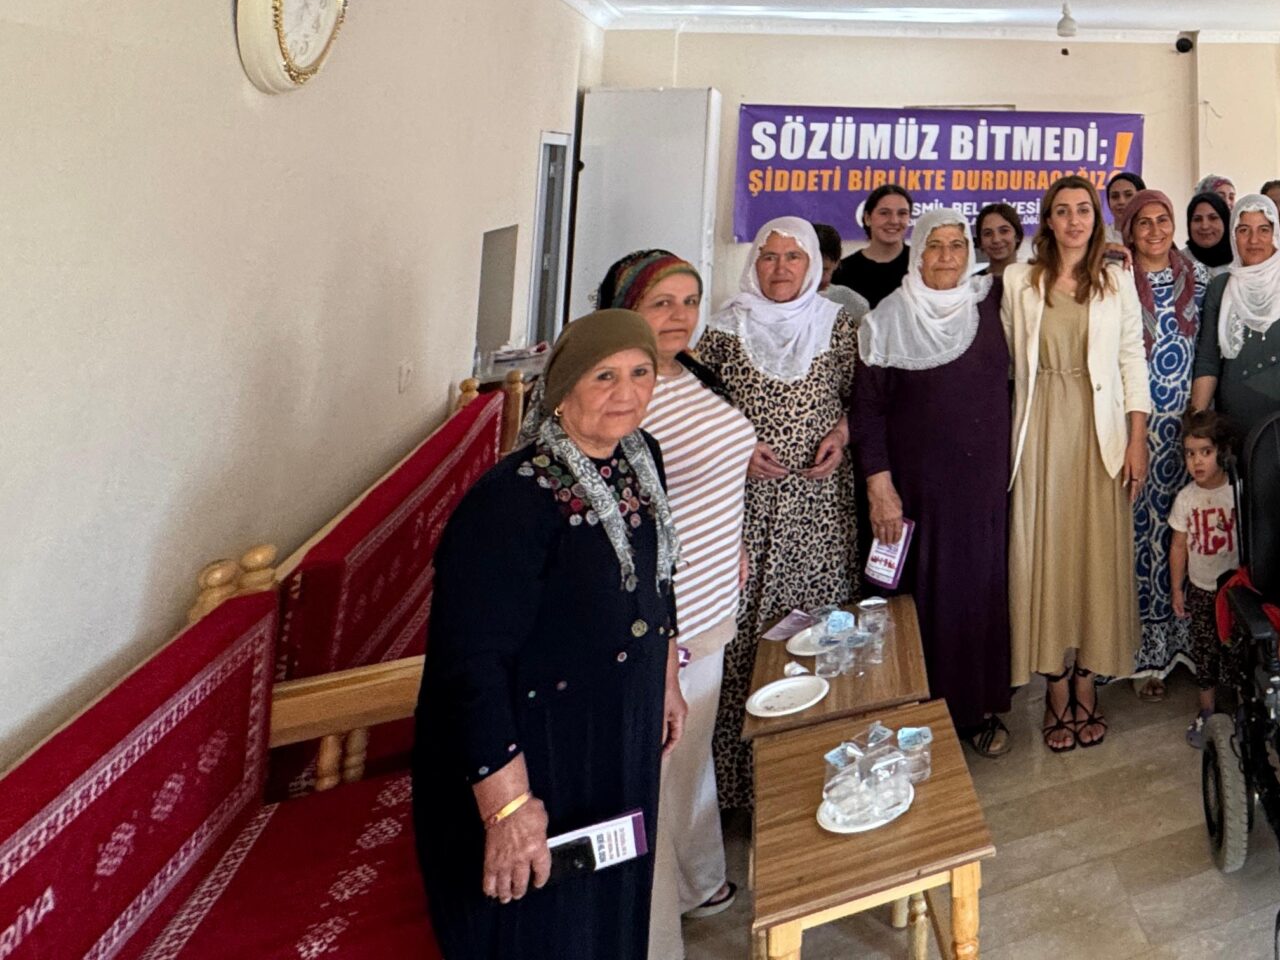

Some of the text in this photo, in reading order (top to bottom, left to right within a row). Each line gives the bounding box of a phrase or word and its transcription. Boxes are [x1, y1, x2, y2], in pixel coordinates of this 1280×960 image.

[751, 115, 1108, 166] SÖZÜMÜZ BİTMEDİ;
[749, 166, 841, 197] ŞİDDETİ
